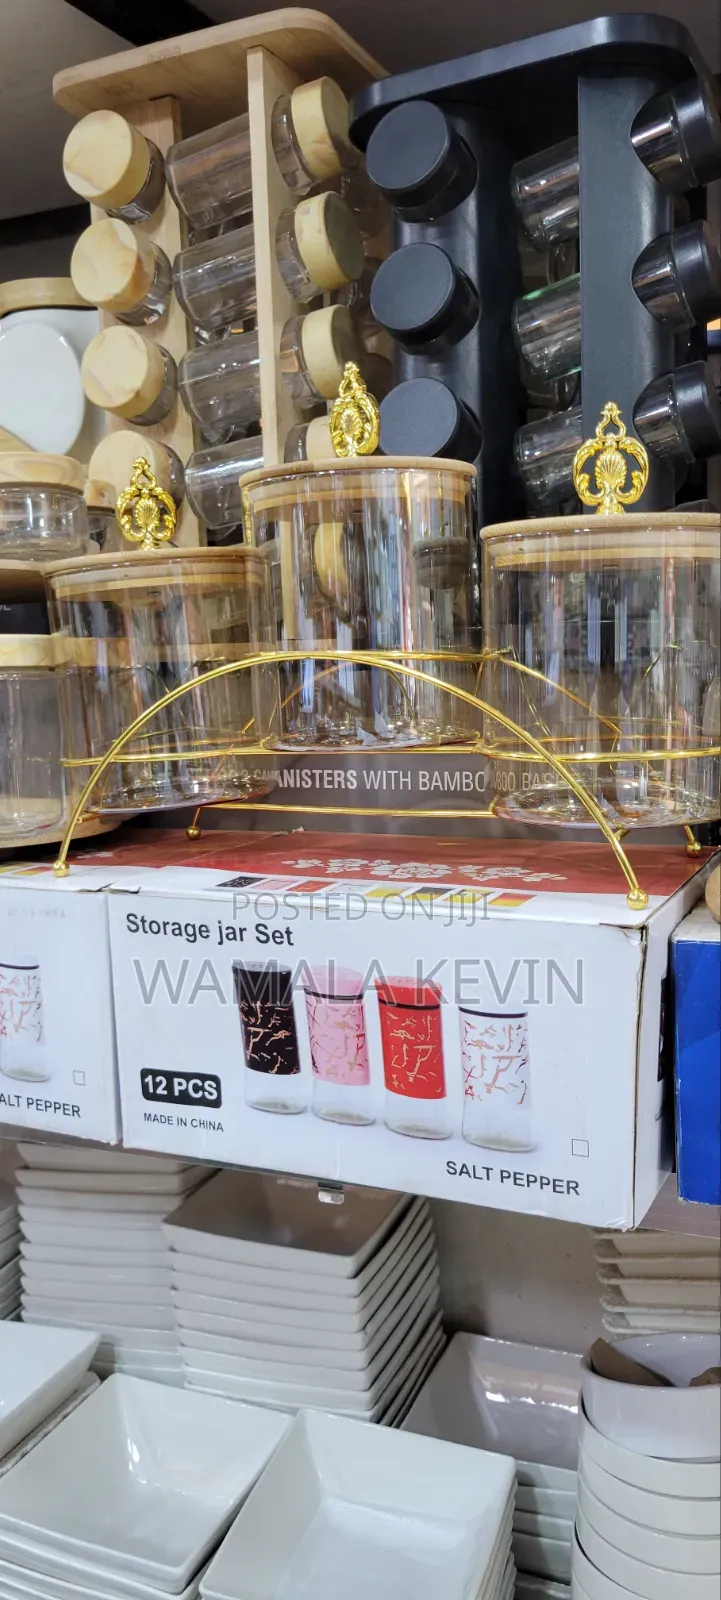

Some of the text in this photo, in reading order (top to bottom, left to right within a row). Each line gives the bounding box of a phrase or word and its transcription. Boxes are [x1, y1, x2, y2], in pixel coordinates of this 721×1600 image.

[363, 769, 412, 791] WITH
[126, 912, 294, 946] Storage jar Set
[144, 1074, 218, 1100] 12 PCS
[0, 1093, 81, 1119] ALT PEPPER
[143, 1112, 224, 1132] MADE IN CHINA
[446, 1160, 581, 1196] SALT PEPPER
